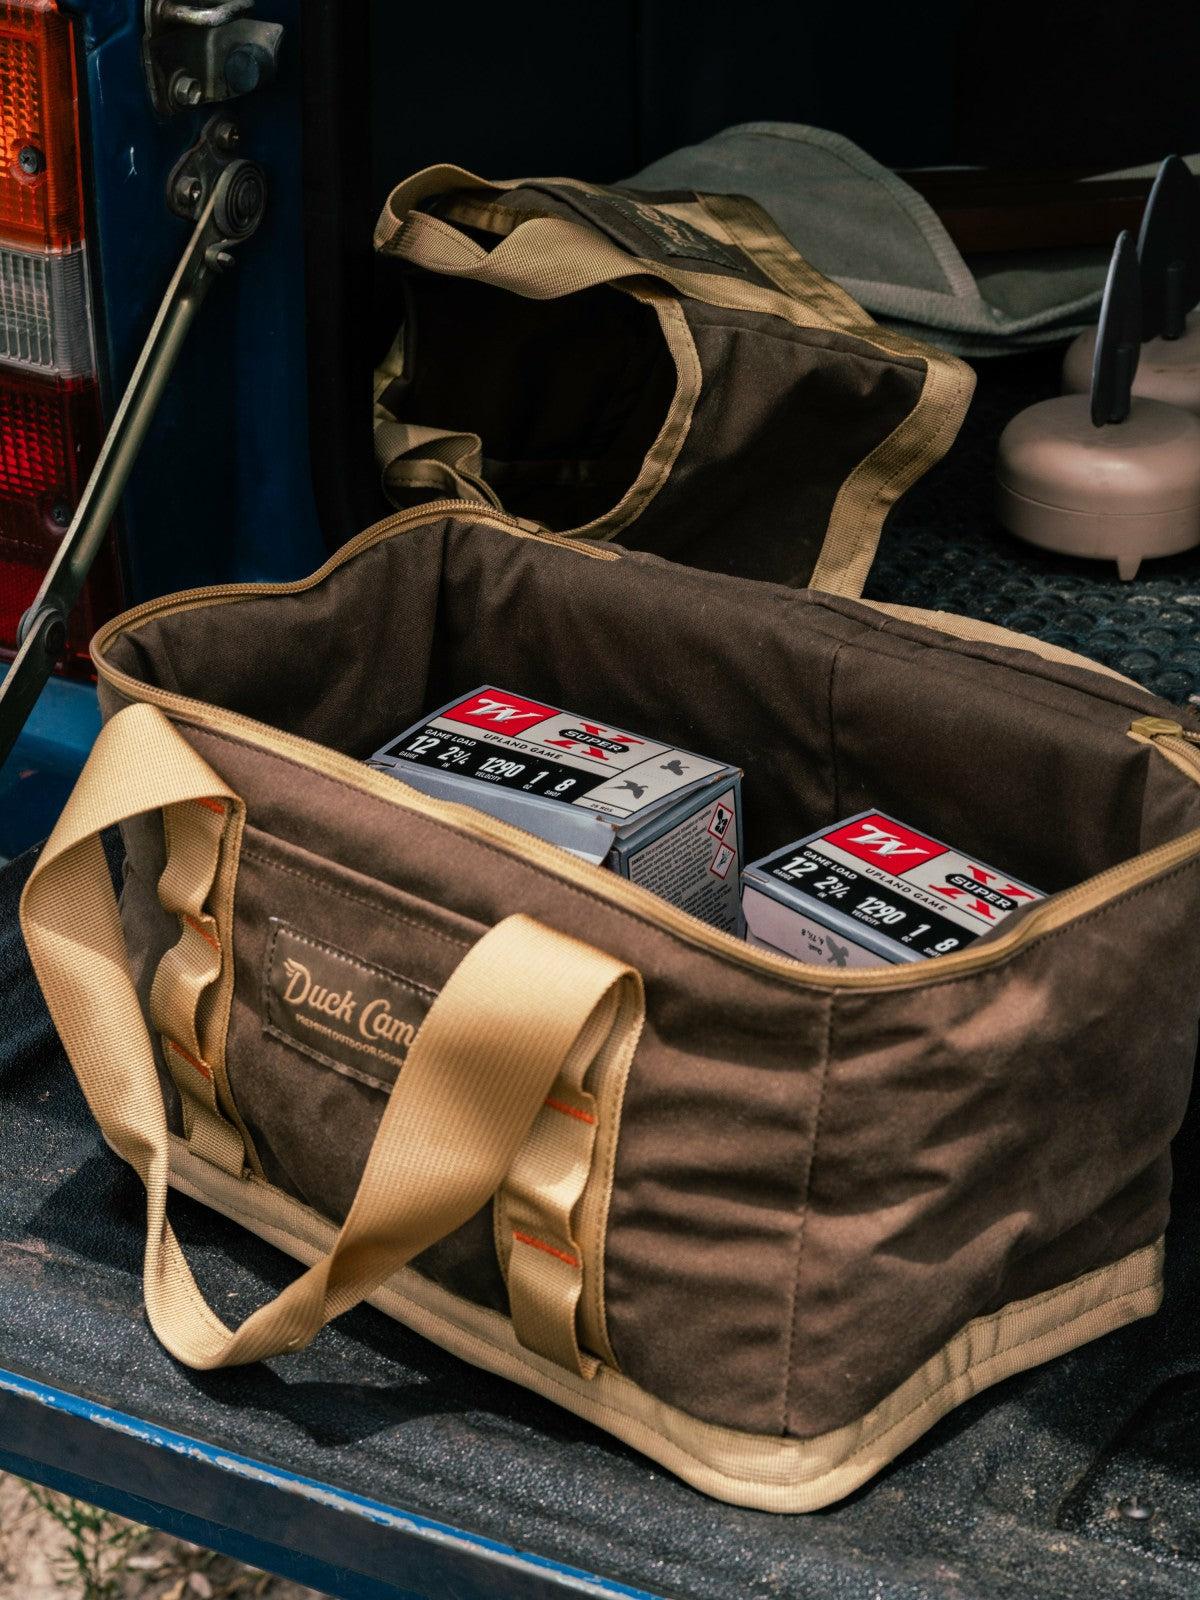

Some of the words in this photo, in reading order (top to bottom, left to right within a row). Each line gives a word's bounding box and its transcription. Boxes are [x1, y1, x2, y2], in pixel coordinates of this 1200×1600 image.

[424, 729, 452, 740] GAME
[451, 736, 477, 747] LOAD
[483, 733, 528, 750] UPLAND
[530, 747, 564, 760] GAME
[564, 730, 623, 752] SUPER
[398, 750, 419, 759] GAUGE
[474, 770, 503, 782] VELOCITY
[544, 789, 561, 798] SHOT
[406, 735, 441, 755] 12
[478, 757, 526, 778] 1290
[529, 771, 550, 785] 1
[554, 778, 577, 792] 8
[803, 850, 833, 867] GAME
[830, 863, 858, 880] LOAD
[772, 868, 795, 881] GAUGE
[851, 909, 881, 926] VELOCITY
[781, 856, 819, 878] 12
[856, 896, 907, 925] 1290
[908, 923, 932, 938] 1
[934, 937, 960, 952] 8
[865, 868, 912, 893] UPLAND
[913, 892, 948, 912] GAME
[950, 875, 1012, 909] SUPER
[283, 957, 358, 1024] Duck
[358, 999, 417, 1049] Cam
[332, 1030, 378, 1056] OUTDOOR
